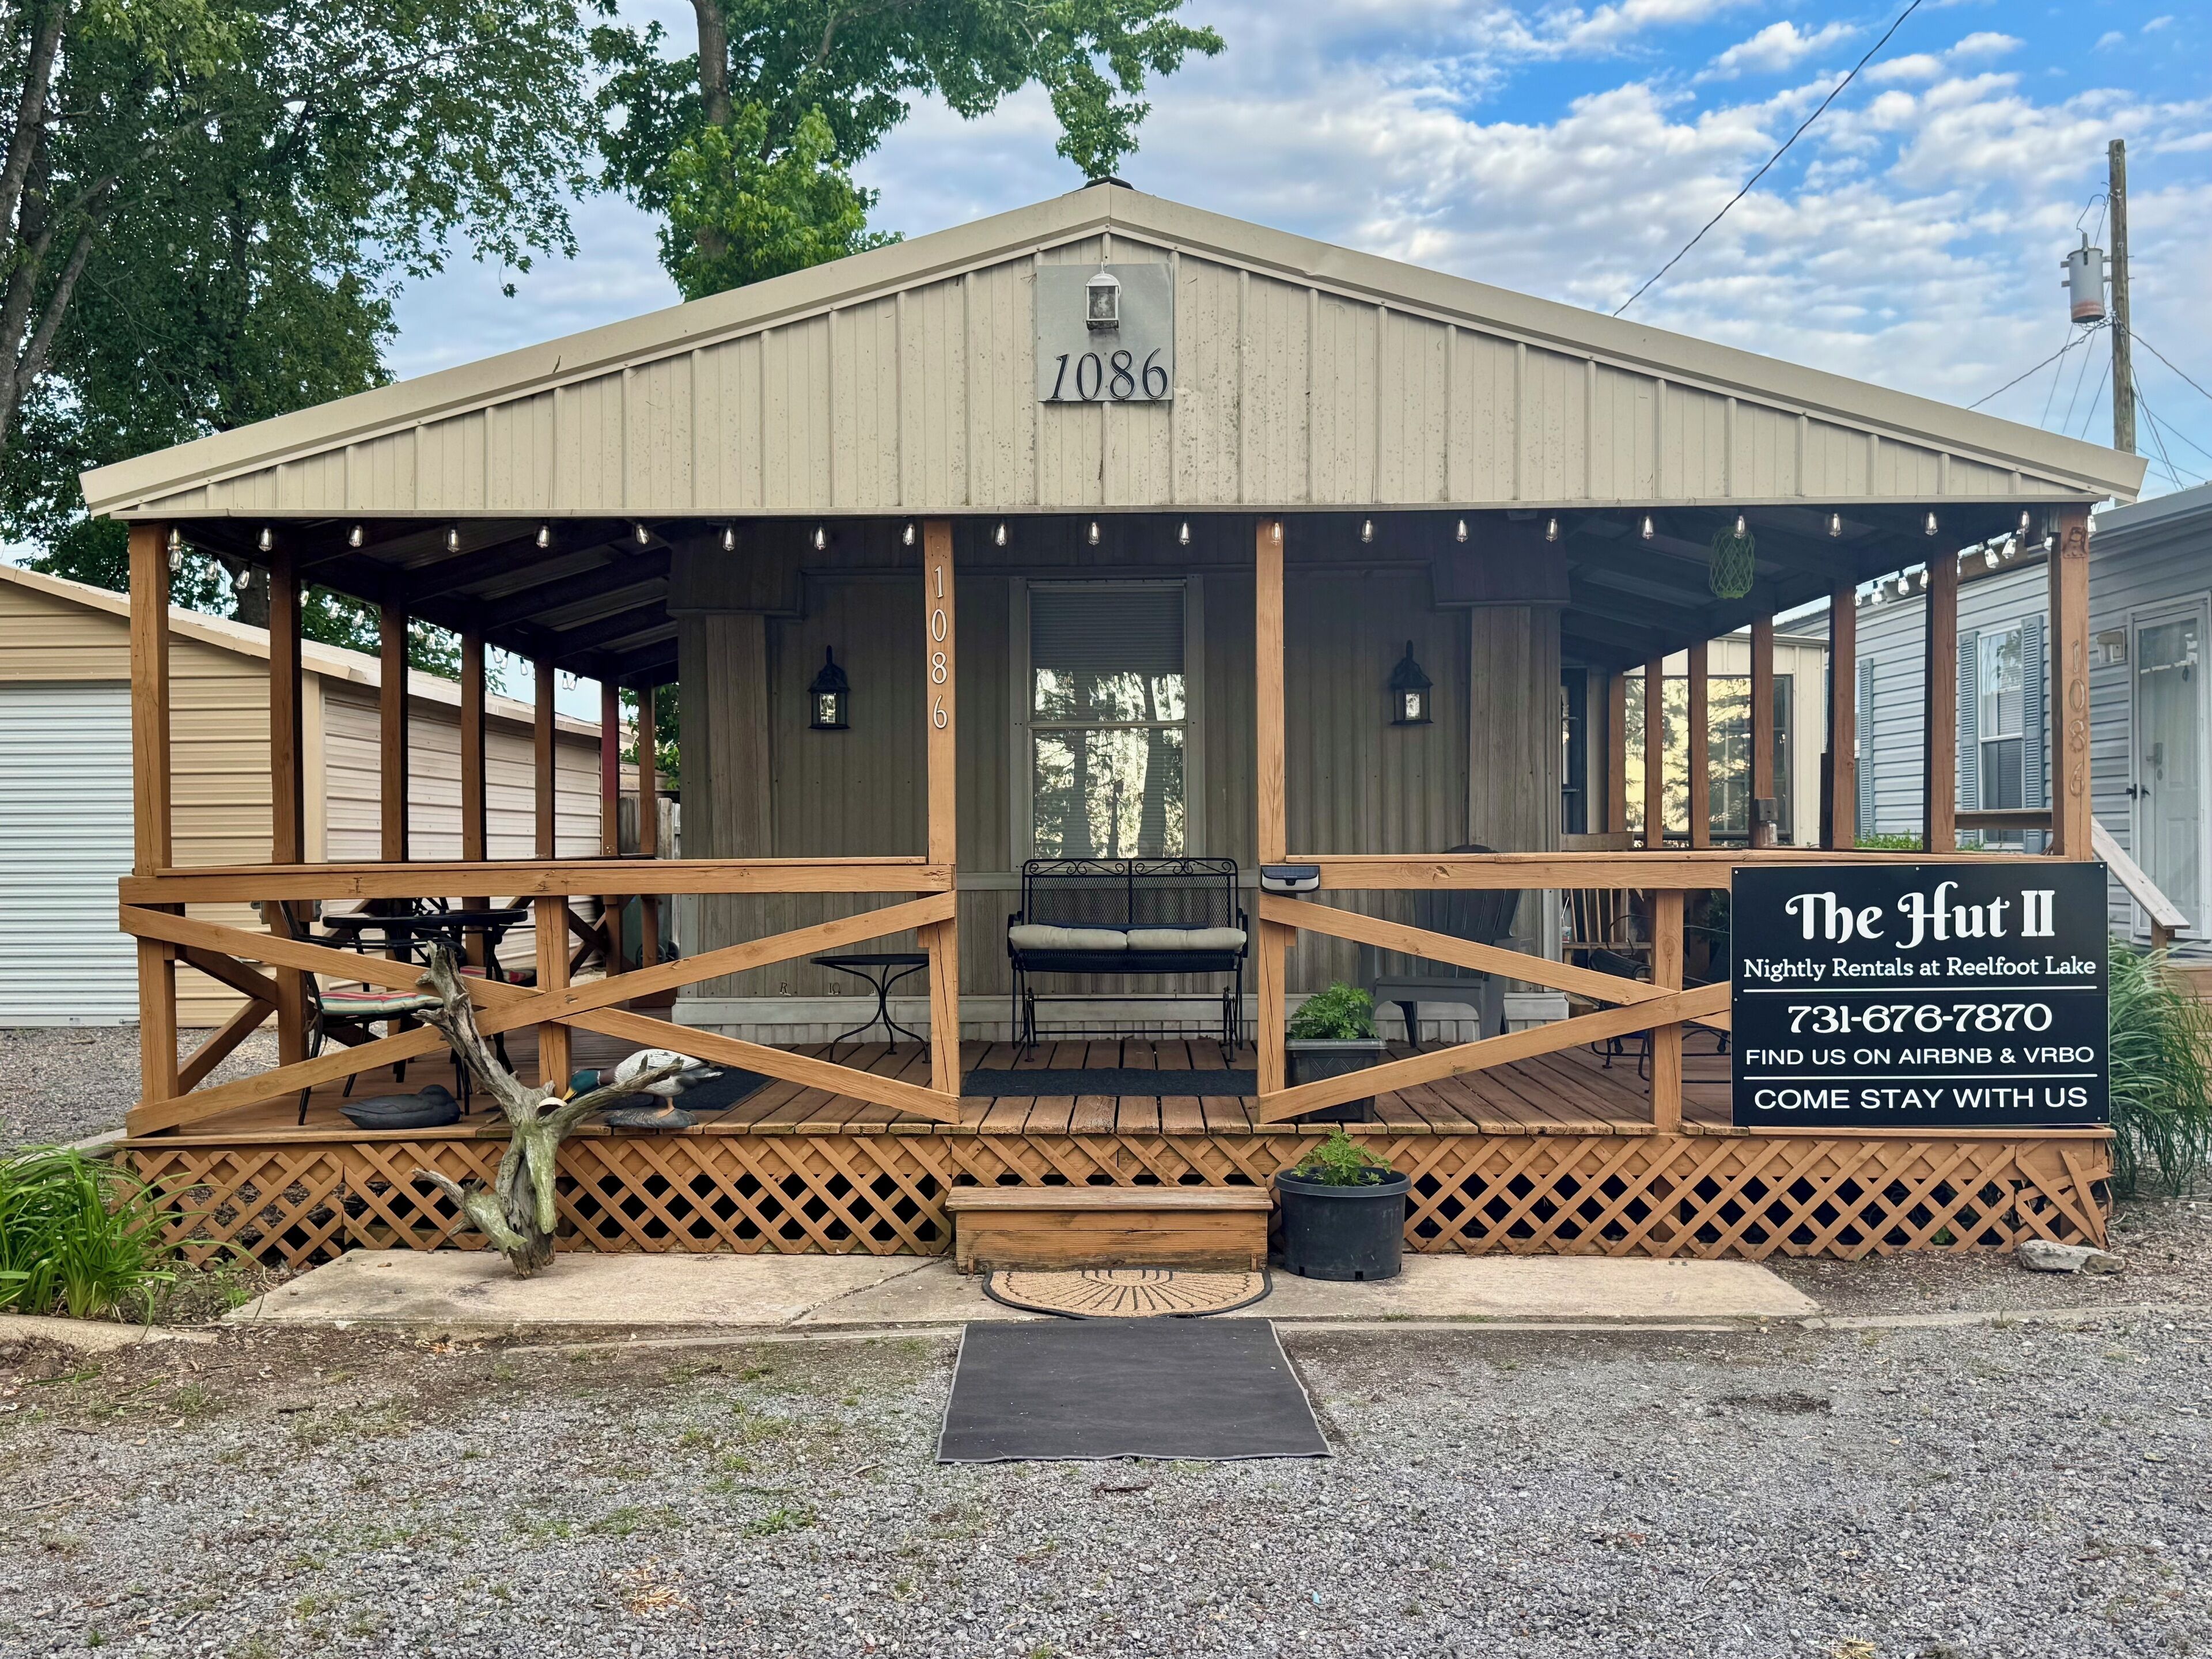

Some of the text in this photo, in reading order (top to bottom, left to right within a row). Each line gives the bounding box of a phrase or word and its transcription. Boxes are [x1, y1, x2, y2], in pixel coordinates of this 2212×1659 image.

[1046, 348, 1168, 400] 1086
[931, 565, 948, 729] 1086
[2069, 639, 2086, 798] 1086
[1785, 881, 2055, 949] The Hut II
[1744, 955, 2096, 982] Nightly Rentals at Reelfoot Lake
[1788, 1003, 2052, 1033] 731-676-7870
[1746, 1046, 2094, 1065] FIND US ON AIRBNB & VRBO
[1754, 1086, 2088, 1109] COME STAY WITH US
